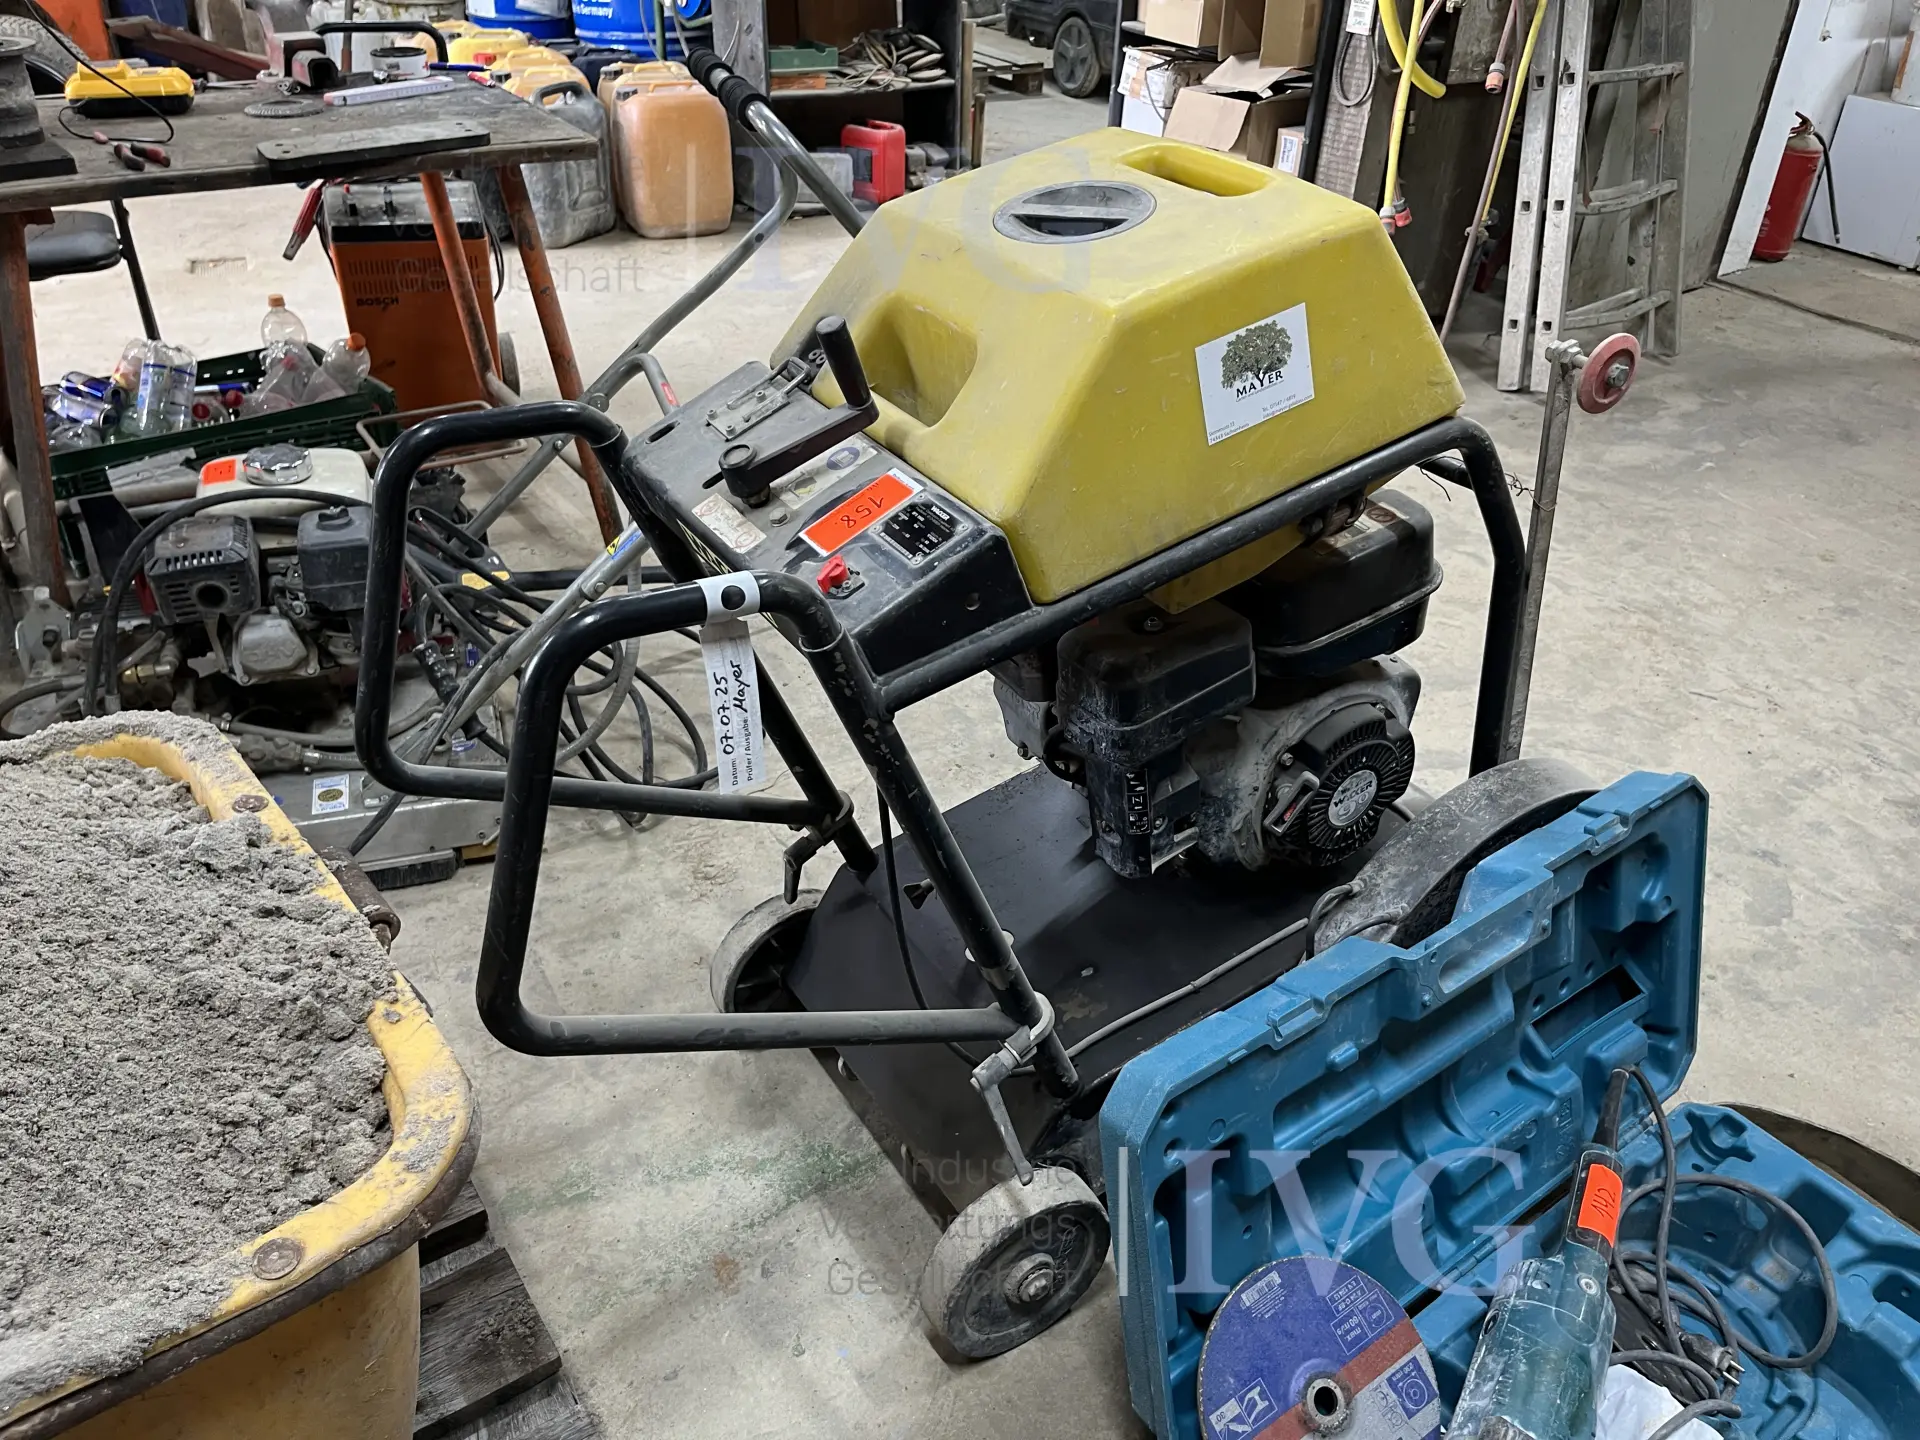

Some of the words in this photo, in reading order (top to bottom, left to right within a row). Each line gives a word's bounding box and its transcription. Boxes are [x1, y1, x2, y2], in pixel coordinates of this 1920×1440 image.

[580, 4, 613, 19] Germany
[356, 297, 399, 307] BOSCH
[1235, 370, 1284, 398] MAYER
[930, 505, 951, 521] WACKER
[730, 659, 751, 713] Mayer
[743, 716, 752, 751] Ausgabe:
[743, 756, 754, 782] Prüfer
[1333, 780, 1373, 808] WACKER
[1344, 1327, 1362, 1342] max.
